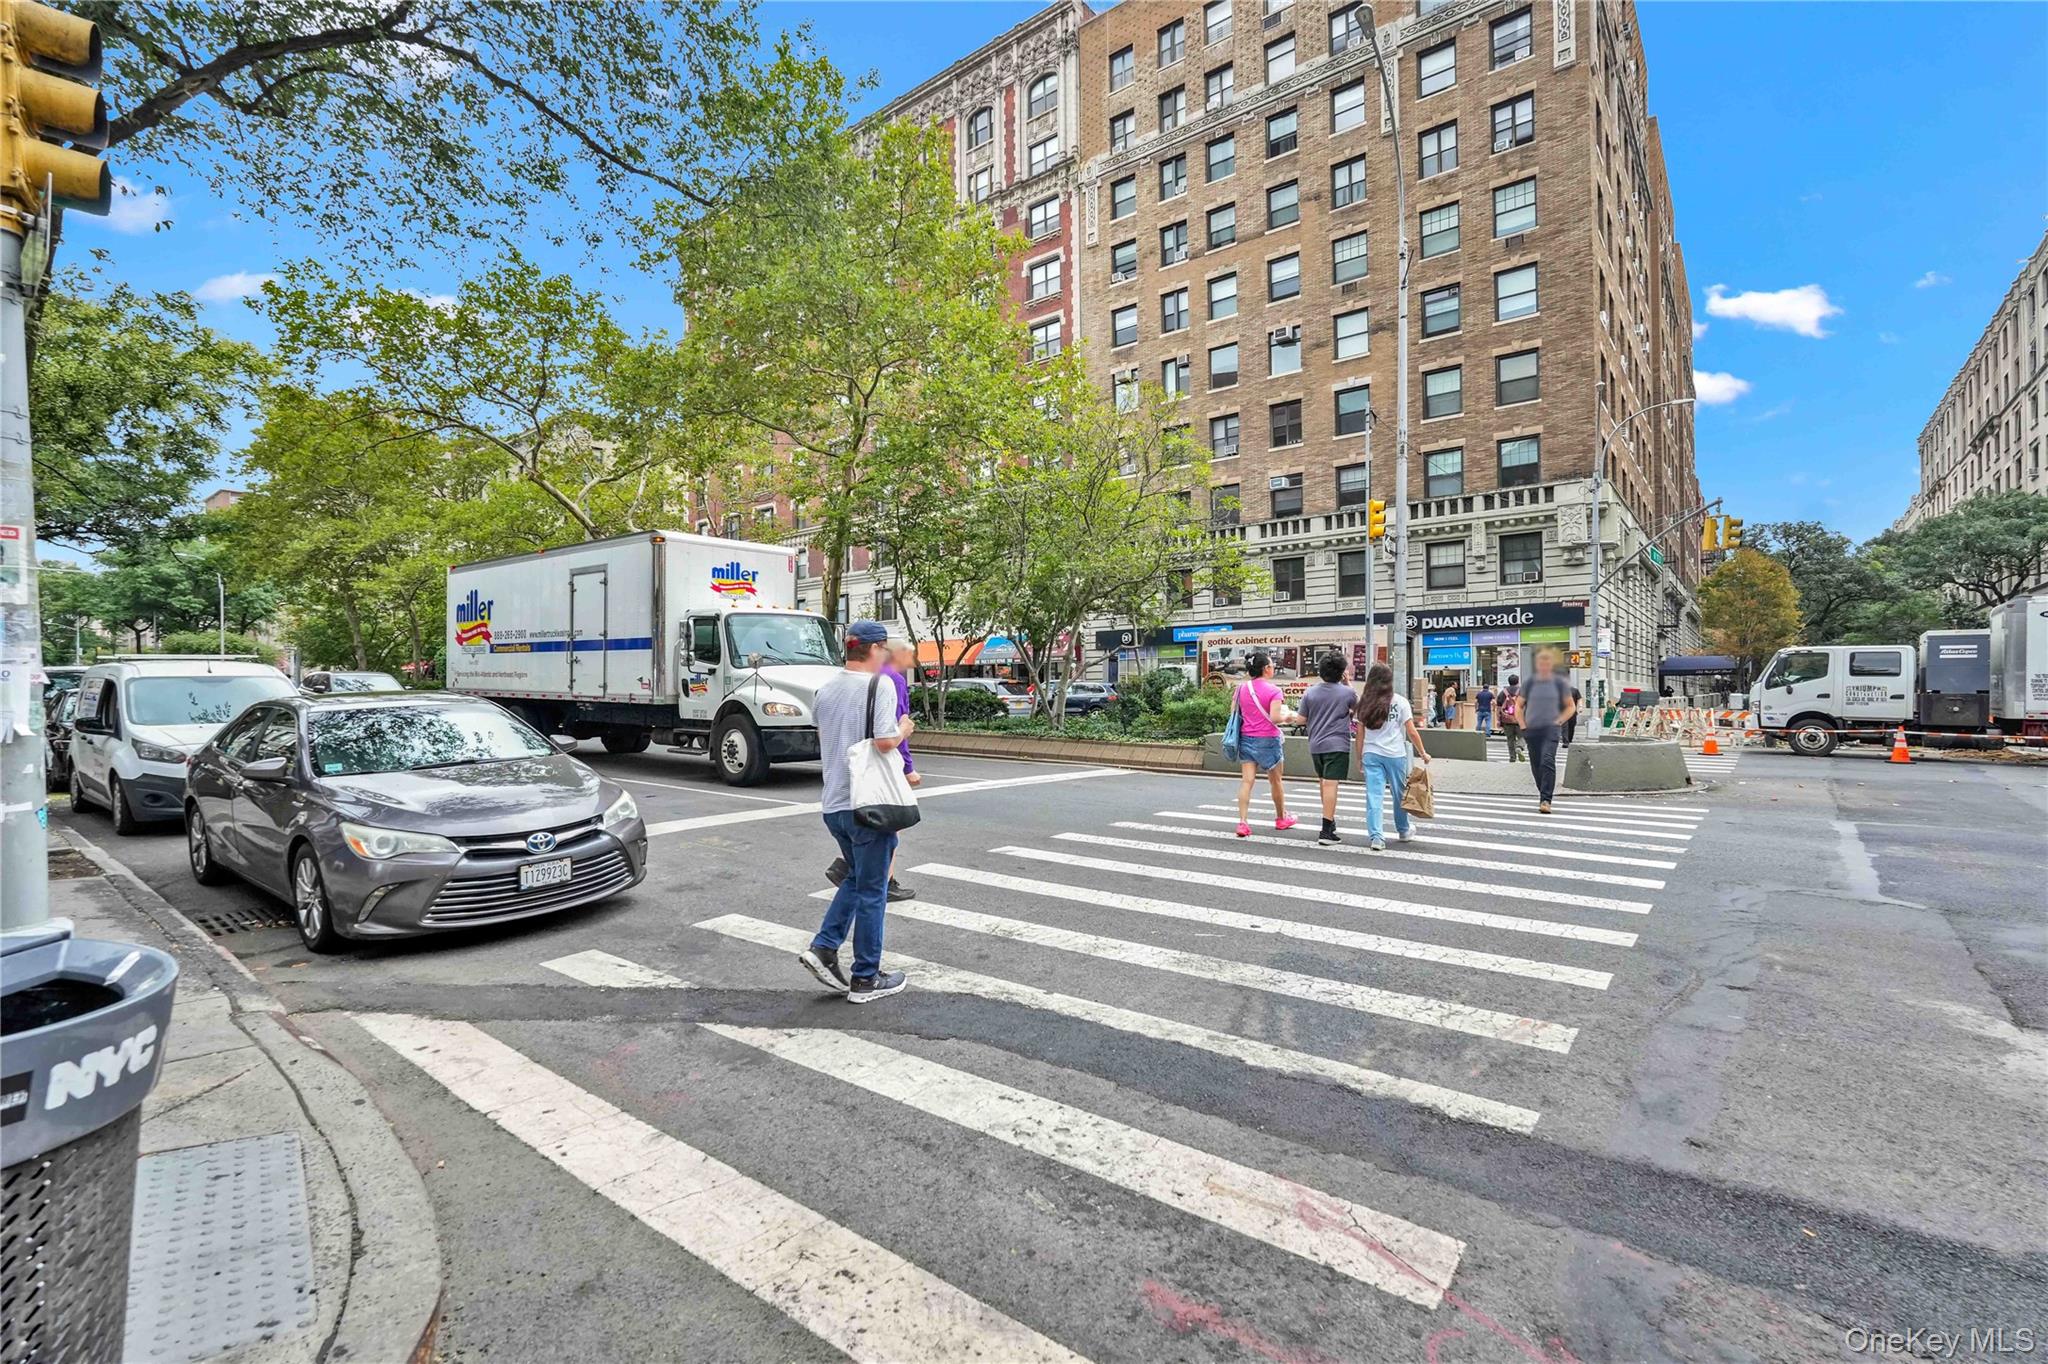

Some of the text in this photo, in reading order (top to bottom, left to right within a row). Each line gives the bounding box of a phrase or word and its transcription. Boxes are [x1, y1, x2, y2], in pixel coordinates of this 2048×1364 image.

[712, 561, 759, 582] miller
[456, 589, 494, 623] miller
[1207, 635, 1291, 647] gothic cabinet craft
[524, 863, 568, 884] T129923C
[44, 1025, 158, 1110] NYC
